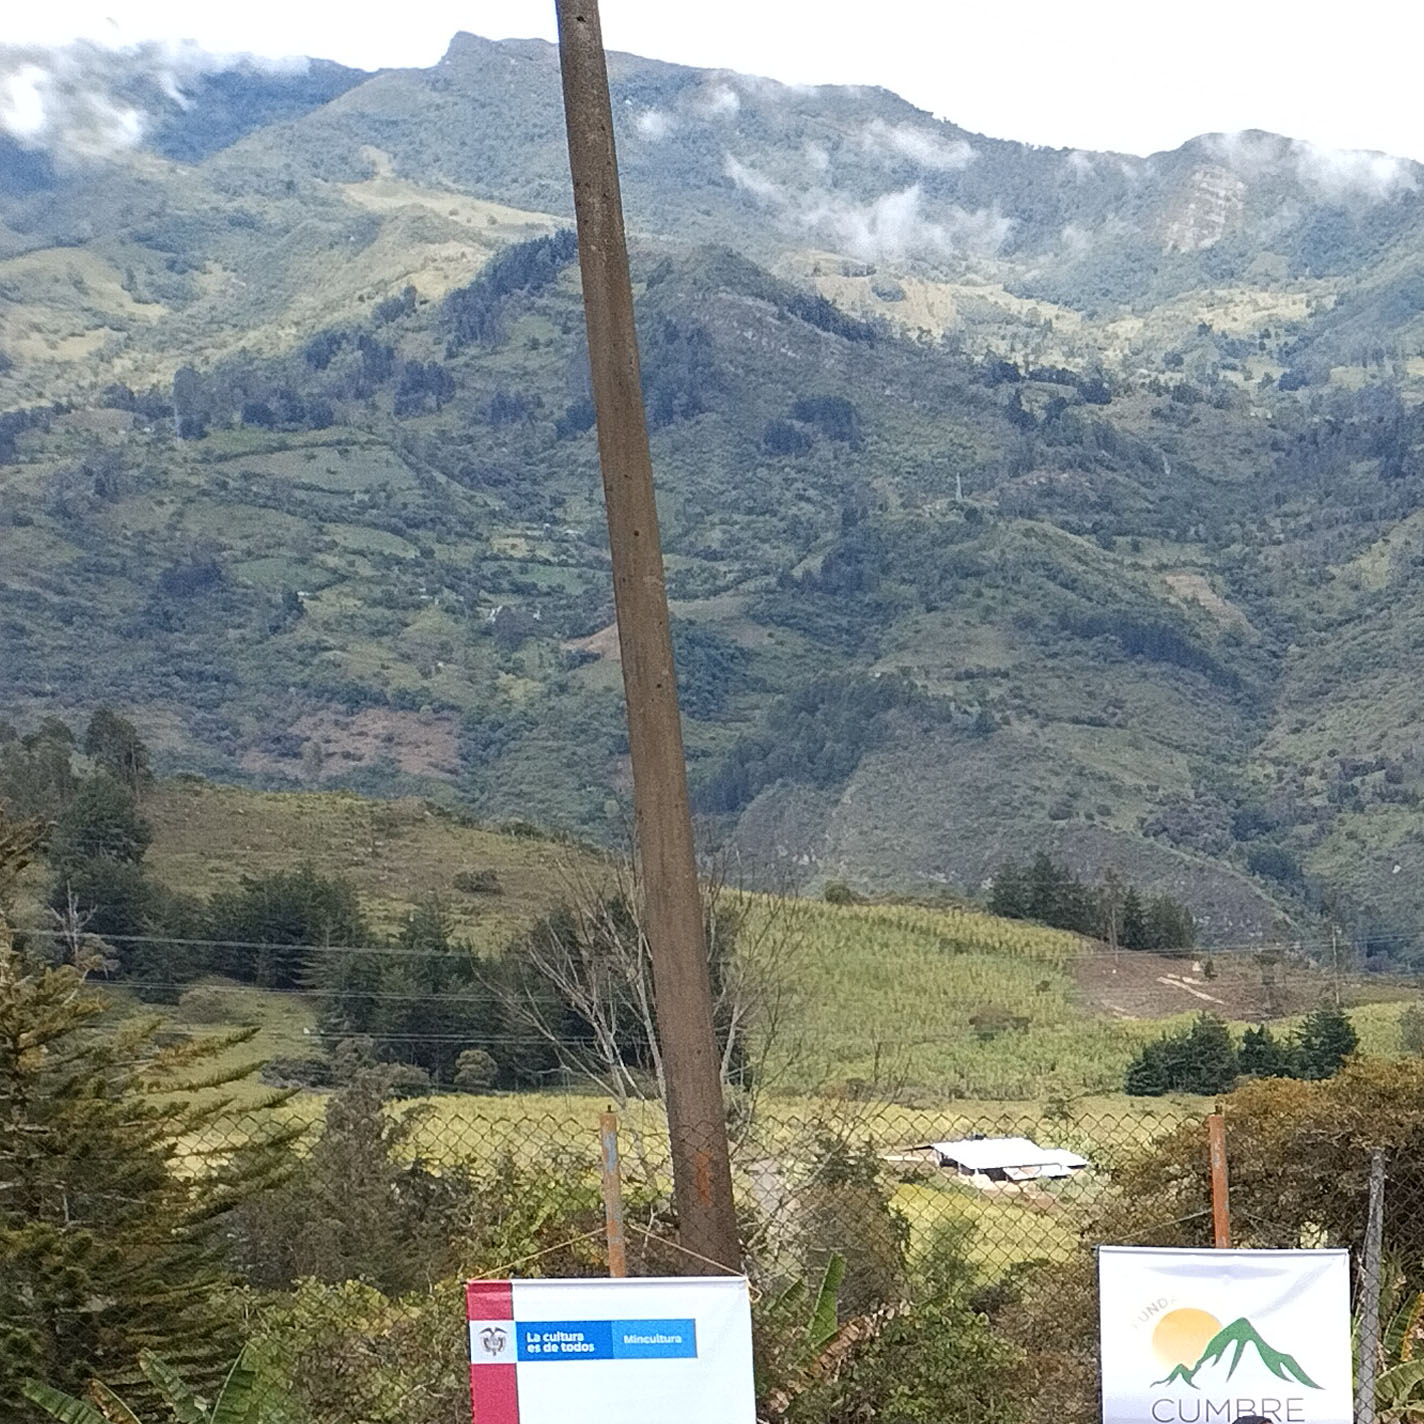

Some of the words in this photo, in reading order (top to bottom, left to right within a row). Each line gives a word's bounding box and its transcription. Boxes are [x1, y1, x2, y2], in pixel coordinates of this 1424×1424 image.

[526, 1332, 541, 1343] La
[543, 1331, 584, 1342] cultura
[623, 1334, 682, 1344] Mincultura
[527, 1343, 541, 1353] es
[543, 1342, 559, 1352] de
[561, 1341, 595, 1353] todos
[1152, 1398, 1305, 1423] CUMBRE
